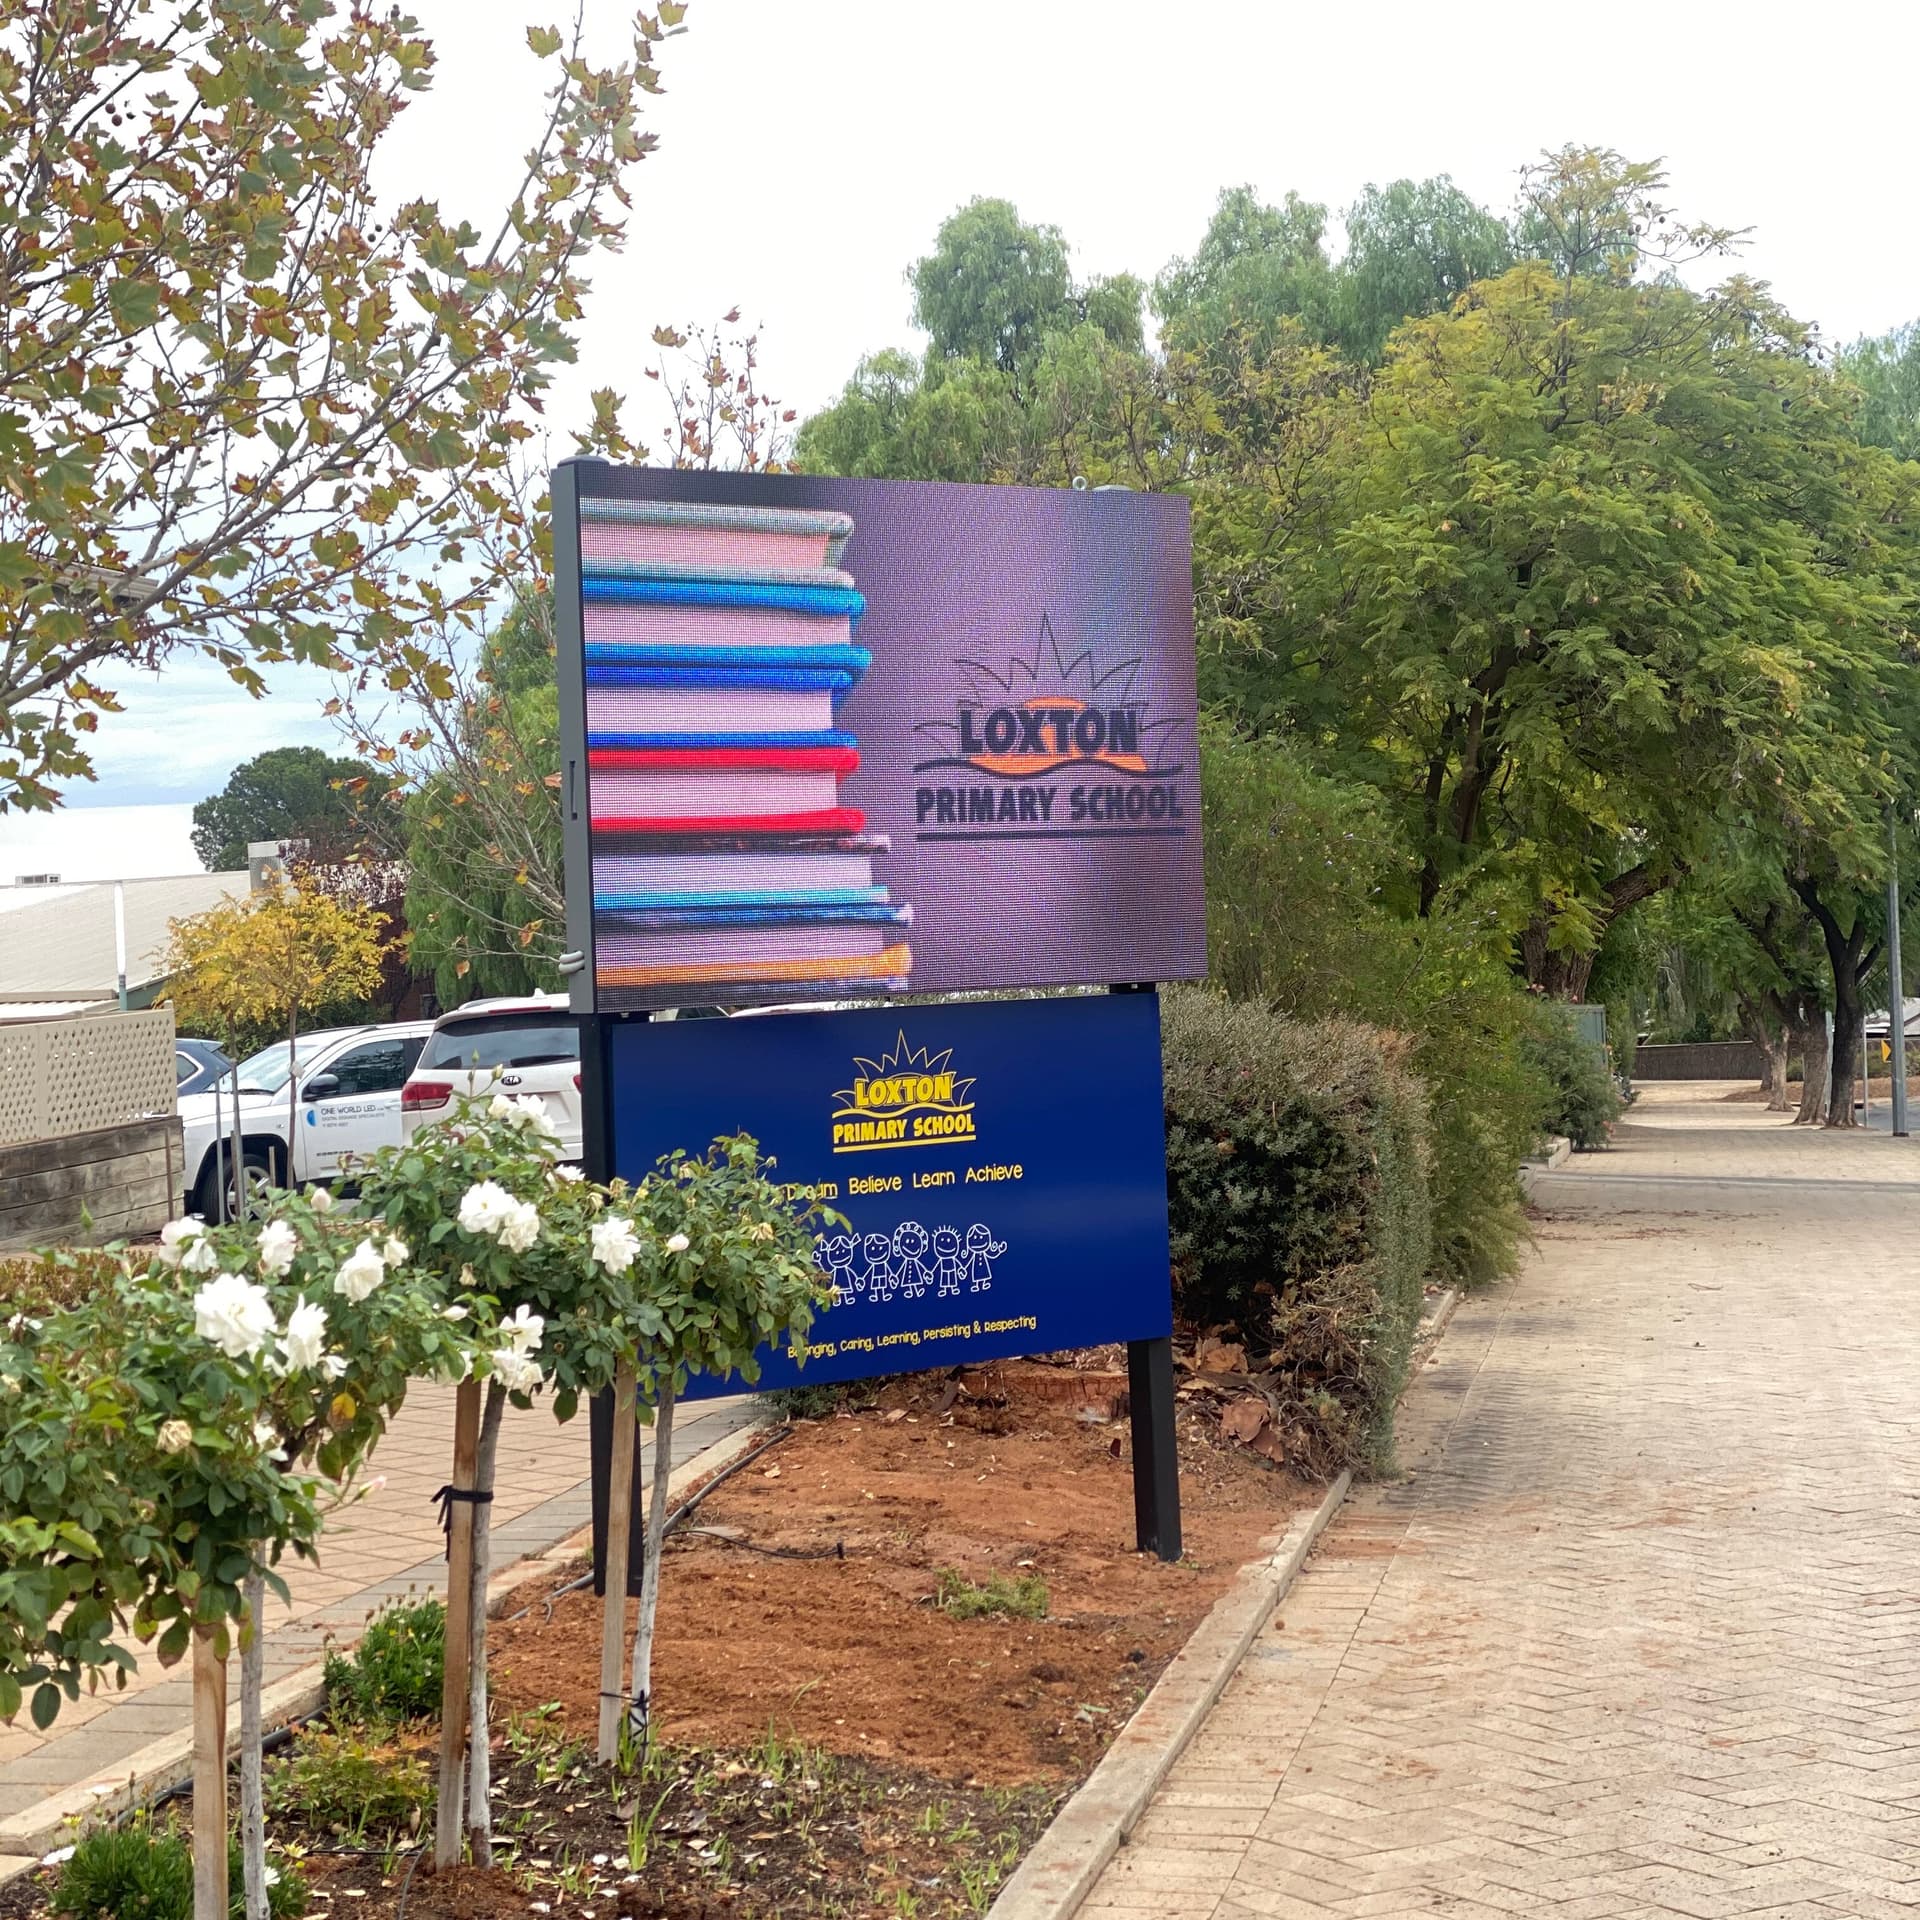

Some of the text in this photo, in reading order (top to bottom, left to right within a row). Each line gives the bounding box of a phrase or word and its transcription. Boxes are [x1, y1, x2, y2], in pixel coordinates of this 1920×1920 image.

[959, 709, 1138, 754] LOXTON
[916, 784, 1184, 823] PRIMARY SCHOOL
[855, 1074, 952, 1108] LOXTON
[320, 1107, 336, 1116] ONE
[337, 1105, 362, 1114] WORLD
[363, 1104, 376, 1113] LED
[833, 1113, 975, 1144] PRIMARY SCHOOL
[786, 1163, 1023, 1201] Deam Believe Learn Achieve
[840, 1336, 874, 1352] Caring,
[877, 1331, 921, 1347] Learning,
[923, 1323, 971, 1340] Persisting
[973, 1320, 982, 1335] &
[984, 1315, 1037, 1332] Respecting
